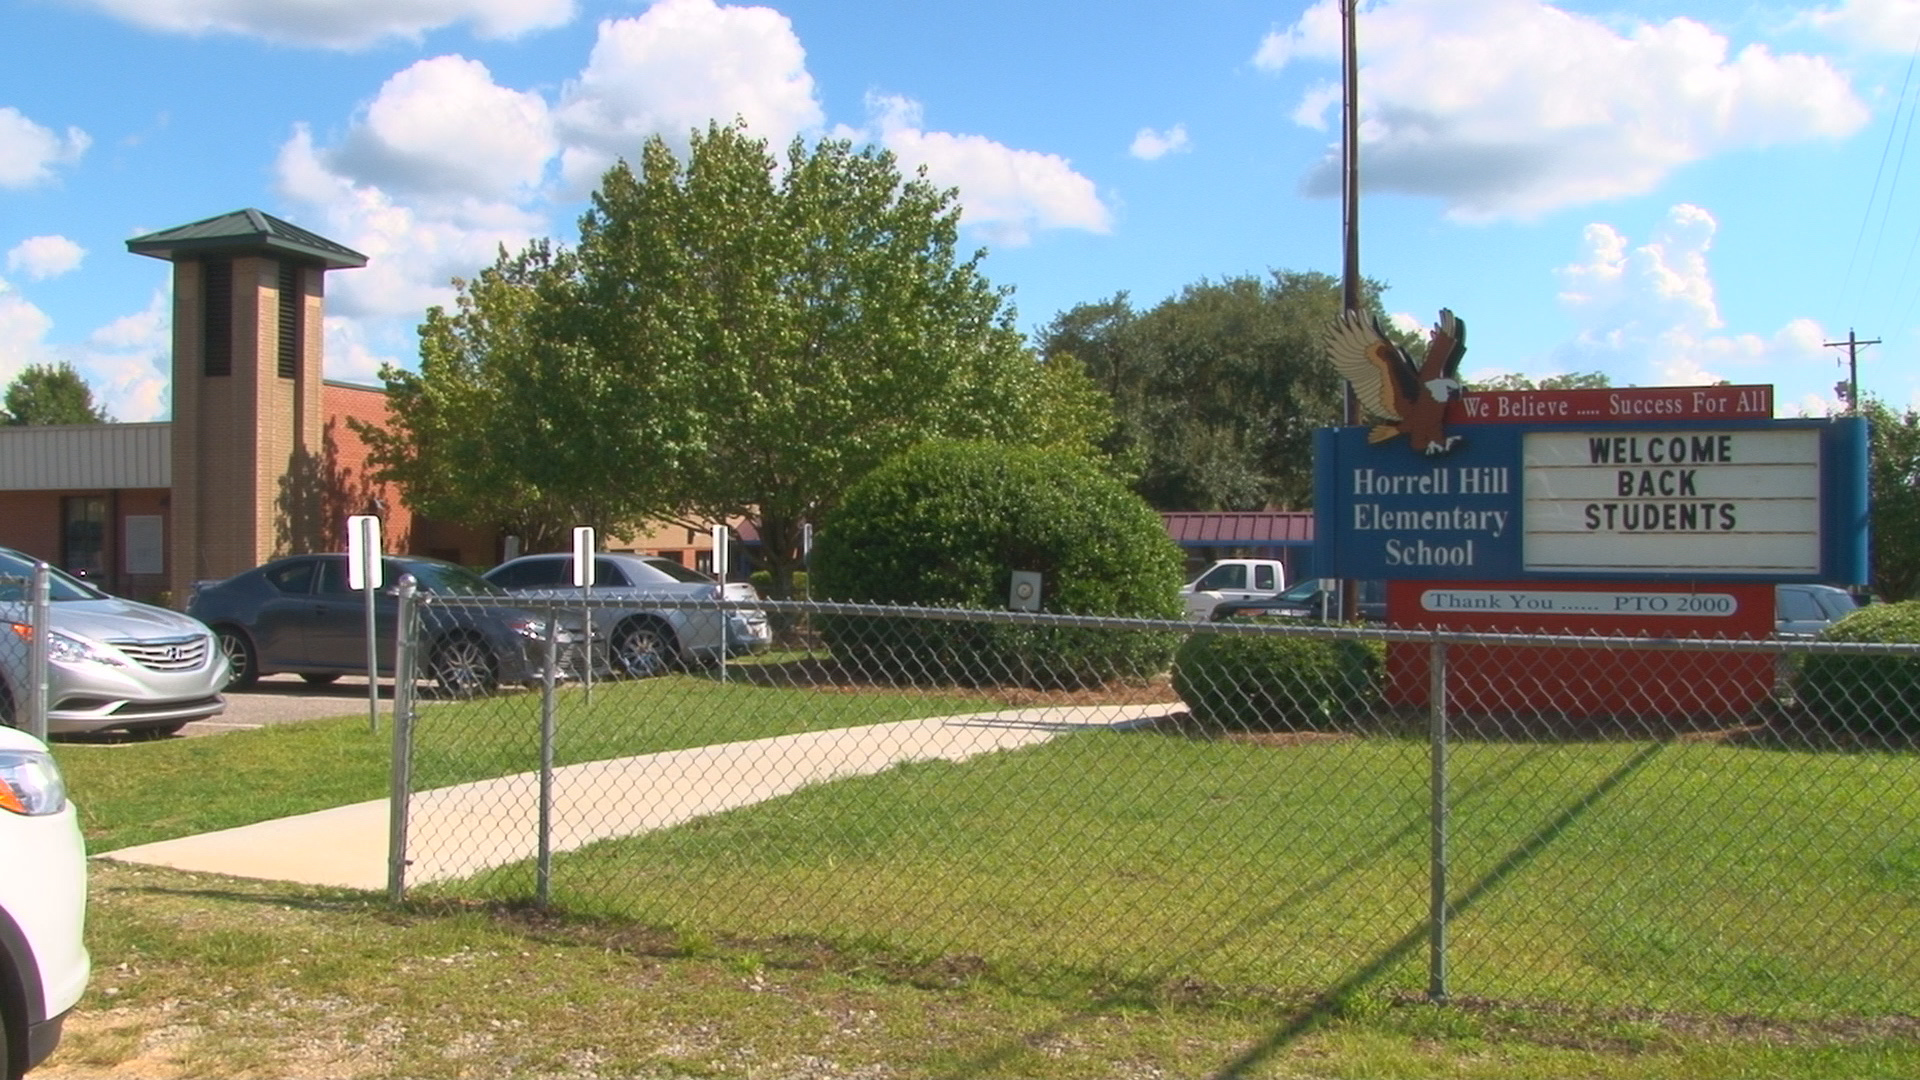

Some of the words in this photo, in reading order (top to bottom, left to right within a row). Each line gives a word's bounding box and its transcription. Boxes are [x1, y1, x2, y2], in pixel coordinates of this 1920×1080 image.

[1463, 396, 1489, 417] We
[1498, 395, 1568, 417] Believe
[1609, 393, 1683, 415] Success
[1692, 391, 1727, 413] For
[1736, 390, 1766, 412] All
[1589, 435, 1732, 463] WELCOME
[1353, 467, 1449, 495] Horrell
[1459, 467, 1509, 494] Hill
[1618, 470, 1697, 496] BACK
[1353, 504, 1509, 538] Elementary
[1585, 503, 1736, 530] STUDENTS
[1385, 538, 1474, 566] School
[1430, 593, 1502, 609] Thank
[1509, 594, 1554, 610] You
[1614, 596, 1668, 611] PTO
[1676, 597, 1730, 613] 2000
